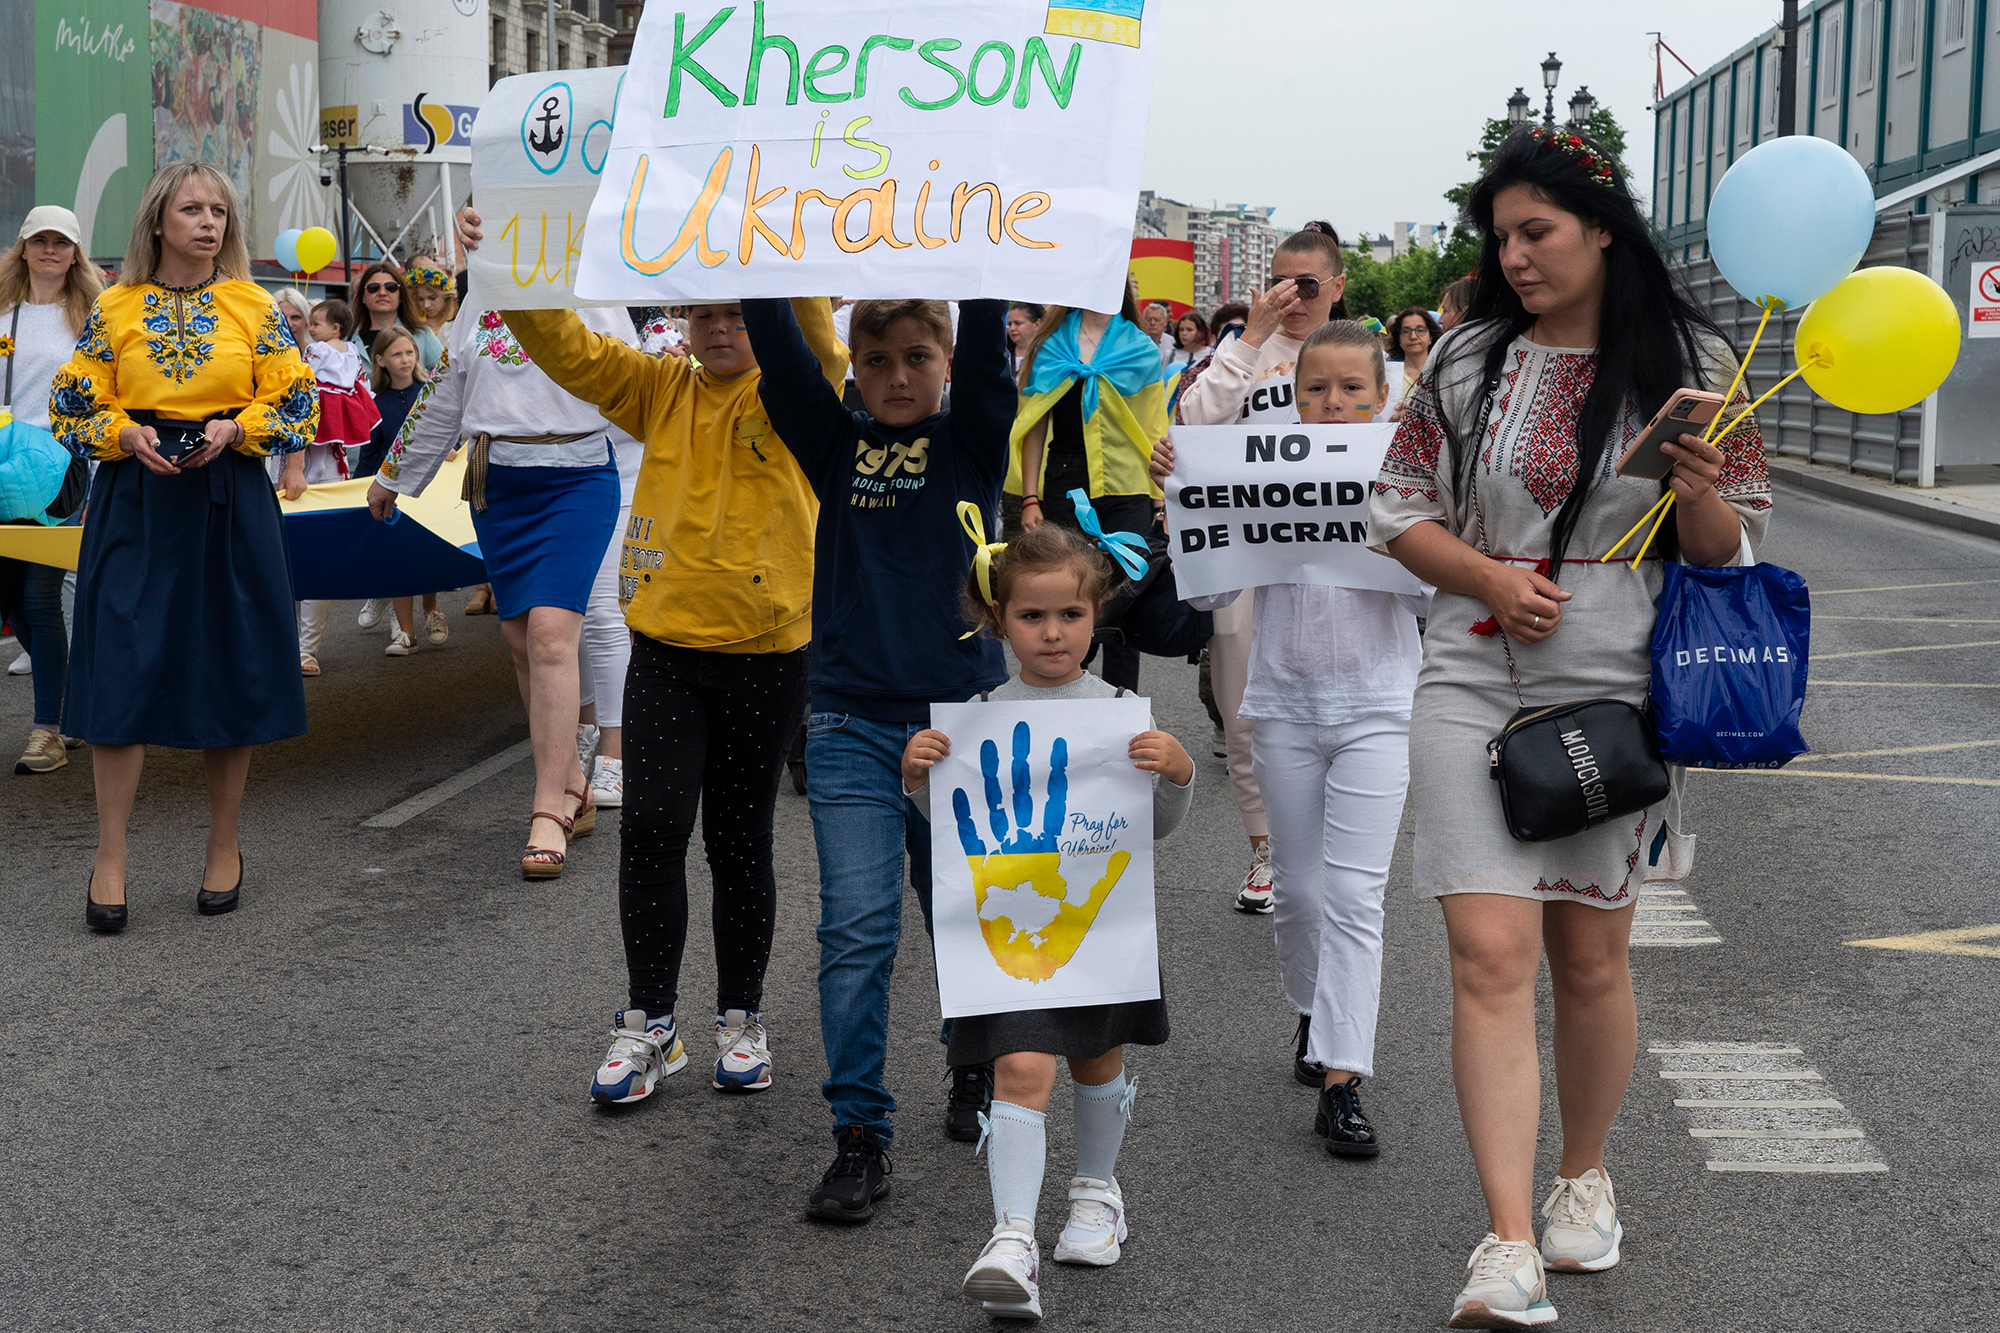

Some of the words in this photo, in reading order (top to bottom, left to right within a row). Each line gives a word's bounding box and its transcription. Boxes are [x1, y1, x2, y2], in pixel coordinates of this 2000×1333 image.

[810, 110, 891, 180] is
[620, 144, 1062, 277] Ukraine
[1245, 434, 1311, 462] NO
[852, 476, 887, 493] ADISE
[890, 476, 925, 490] FOUND
[1179, 481, 1376, 509] GENOCID
[850, 493, 896, 509] HAWAII
[1180, 524, 1230, 554] DE
[1676, 646, 1788, 666] DECIMAS
[1069, 812, 1104, 843] Pray
[1105, 811, 1129, 841] for
[1060, 838, 1117, 857] Ukraine!
